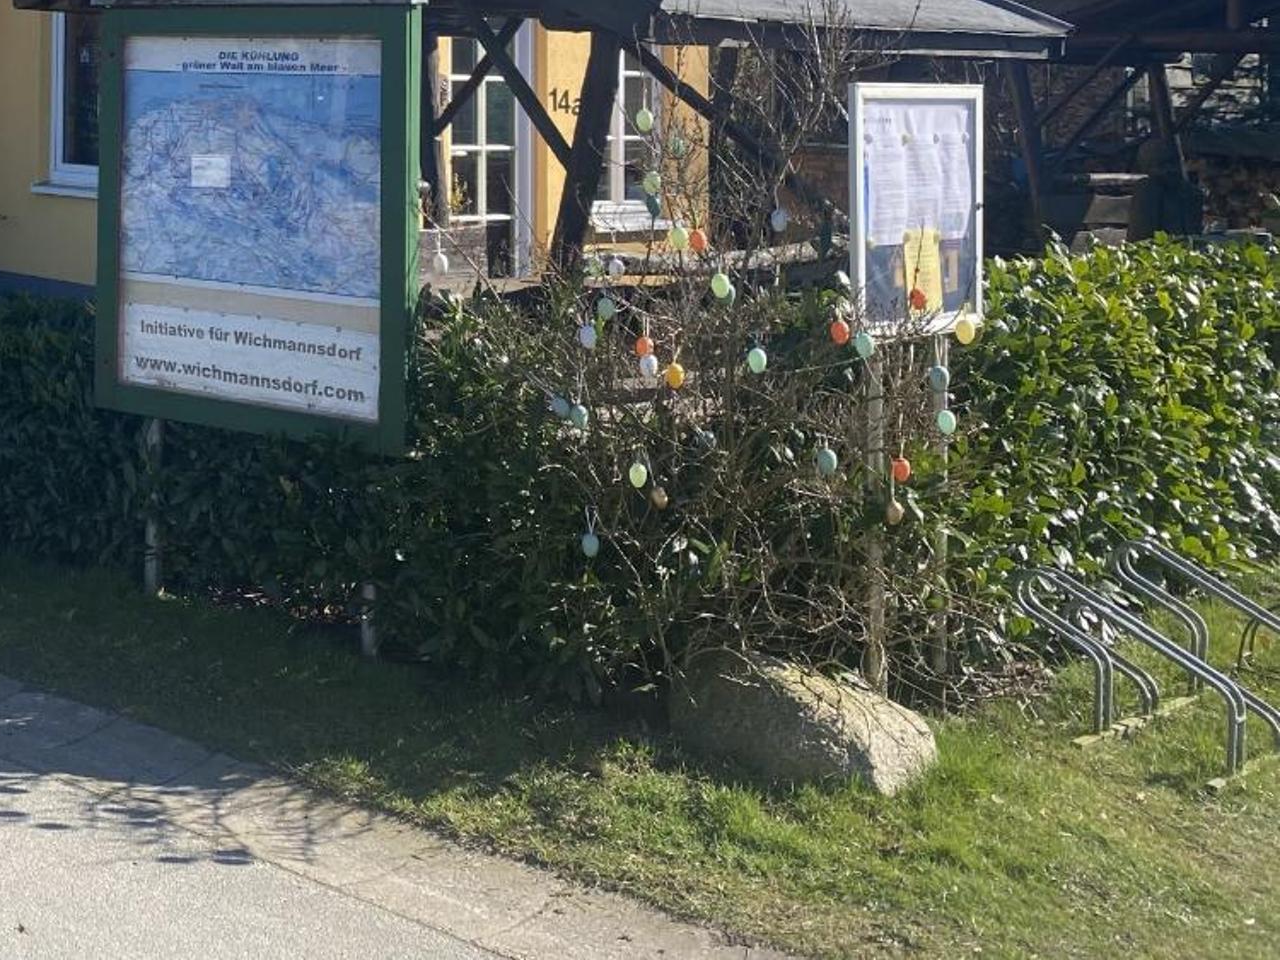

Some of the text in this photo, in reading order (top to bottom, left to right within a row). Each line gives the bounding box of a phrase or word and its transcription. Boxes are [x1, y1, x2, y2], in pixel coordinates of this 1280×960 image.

[218, 51, 238, 61] DIE
[246, 63, 264, 71] am
[310, 63, 338, 72] Meer
[549, 88, 582, 116] 14a
[140, 319, 364, 361] Initiative für Wichmannsdorf
[135, 355, 365, 403] www.wichmannsdorf.com
